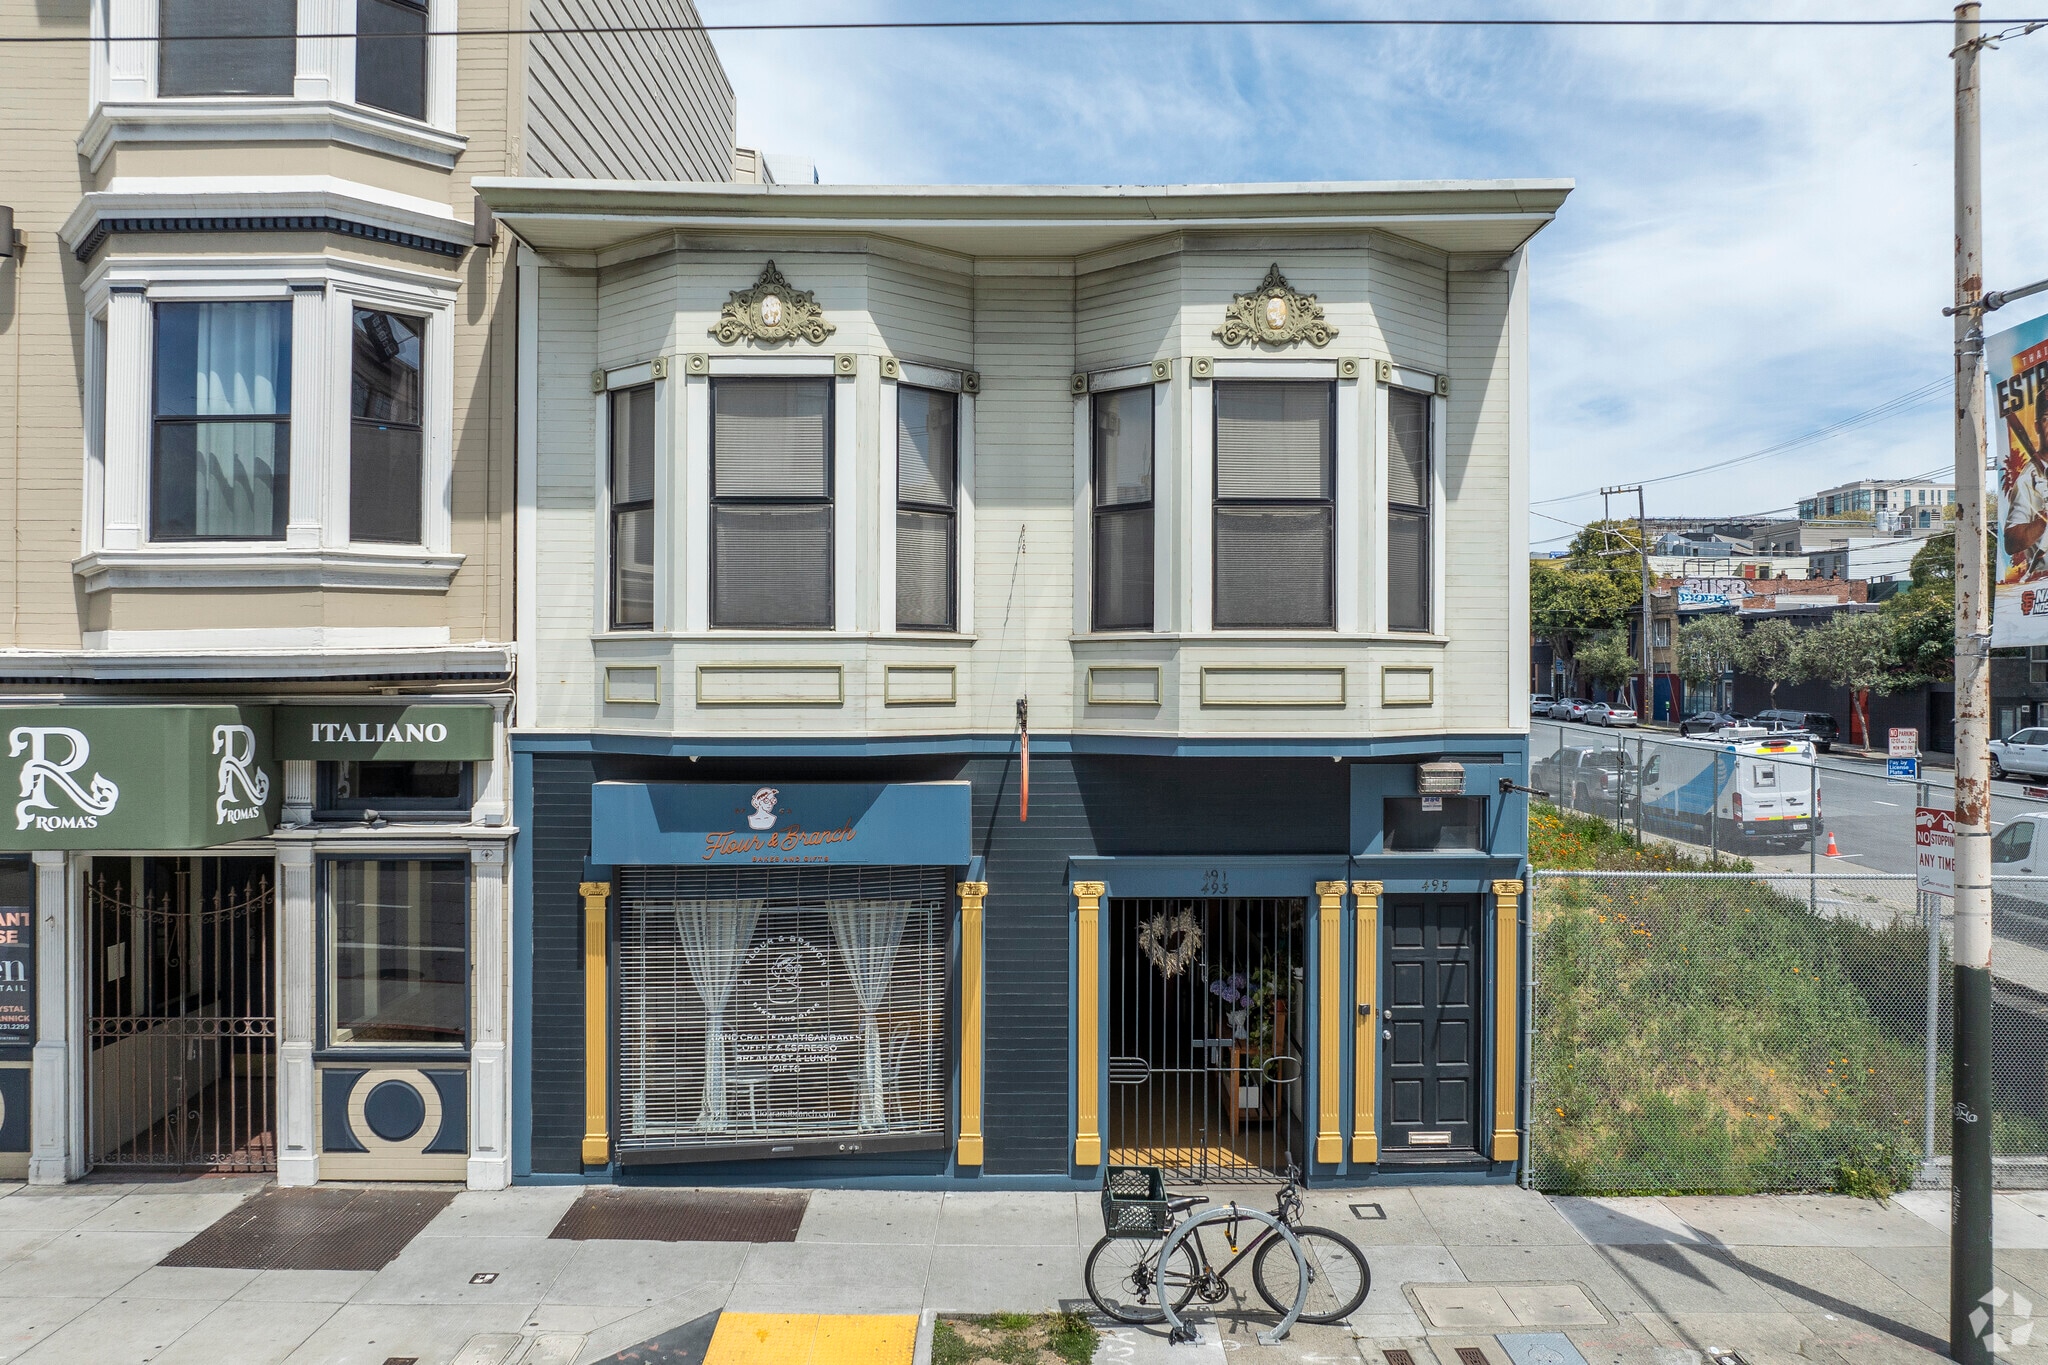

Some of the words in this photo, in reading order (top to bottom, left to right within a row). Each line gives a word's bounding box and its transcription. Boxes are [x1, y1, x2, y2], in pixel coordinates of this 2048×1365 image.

[311, 723, 447, 743] ITALIANO
[702, 830, 765, 860] Flour
[767, 832, 779, 848] &
[780, 816, 857, 851] Branch
[1917, 831, 1930, 843] NO
[1919, 853, 1935, 867] ANY
[1938, 856, 1955, 872] TIME
[1422, 880, 1448, 892] 495
